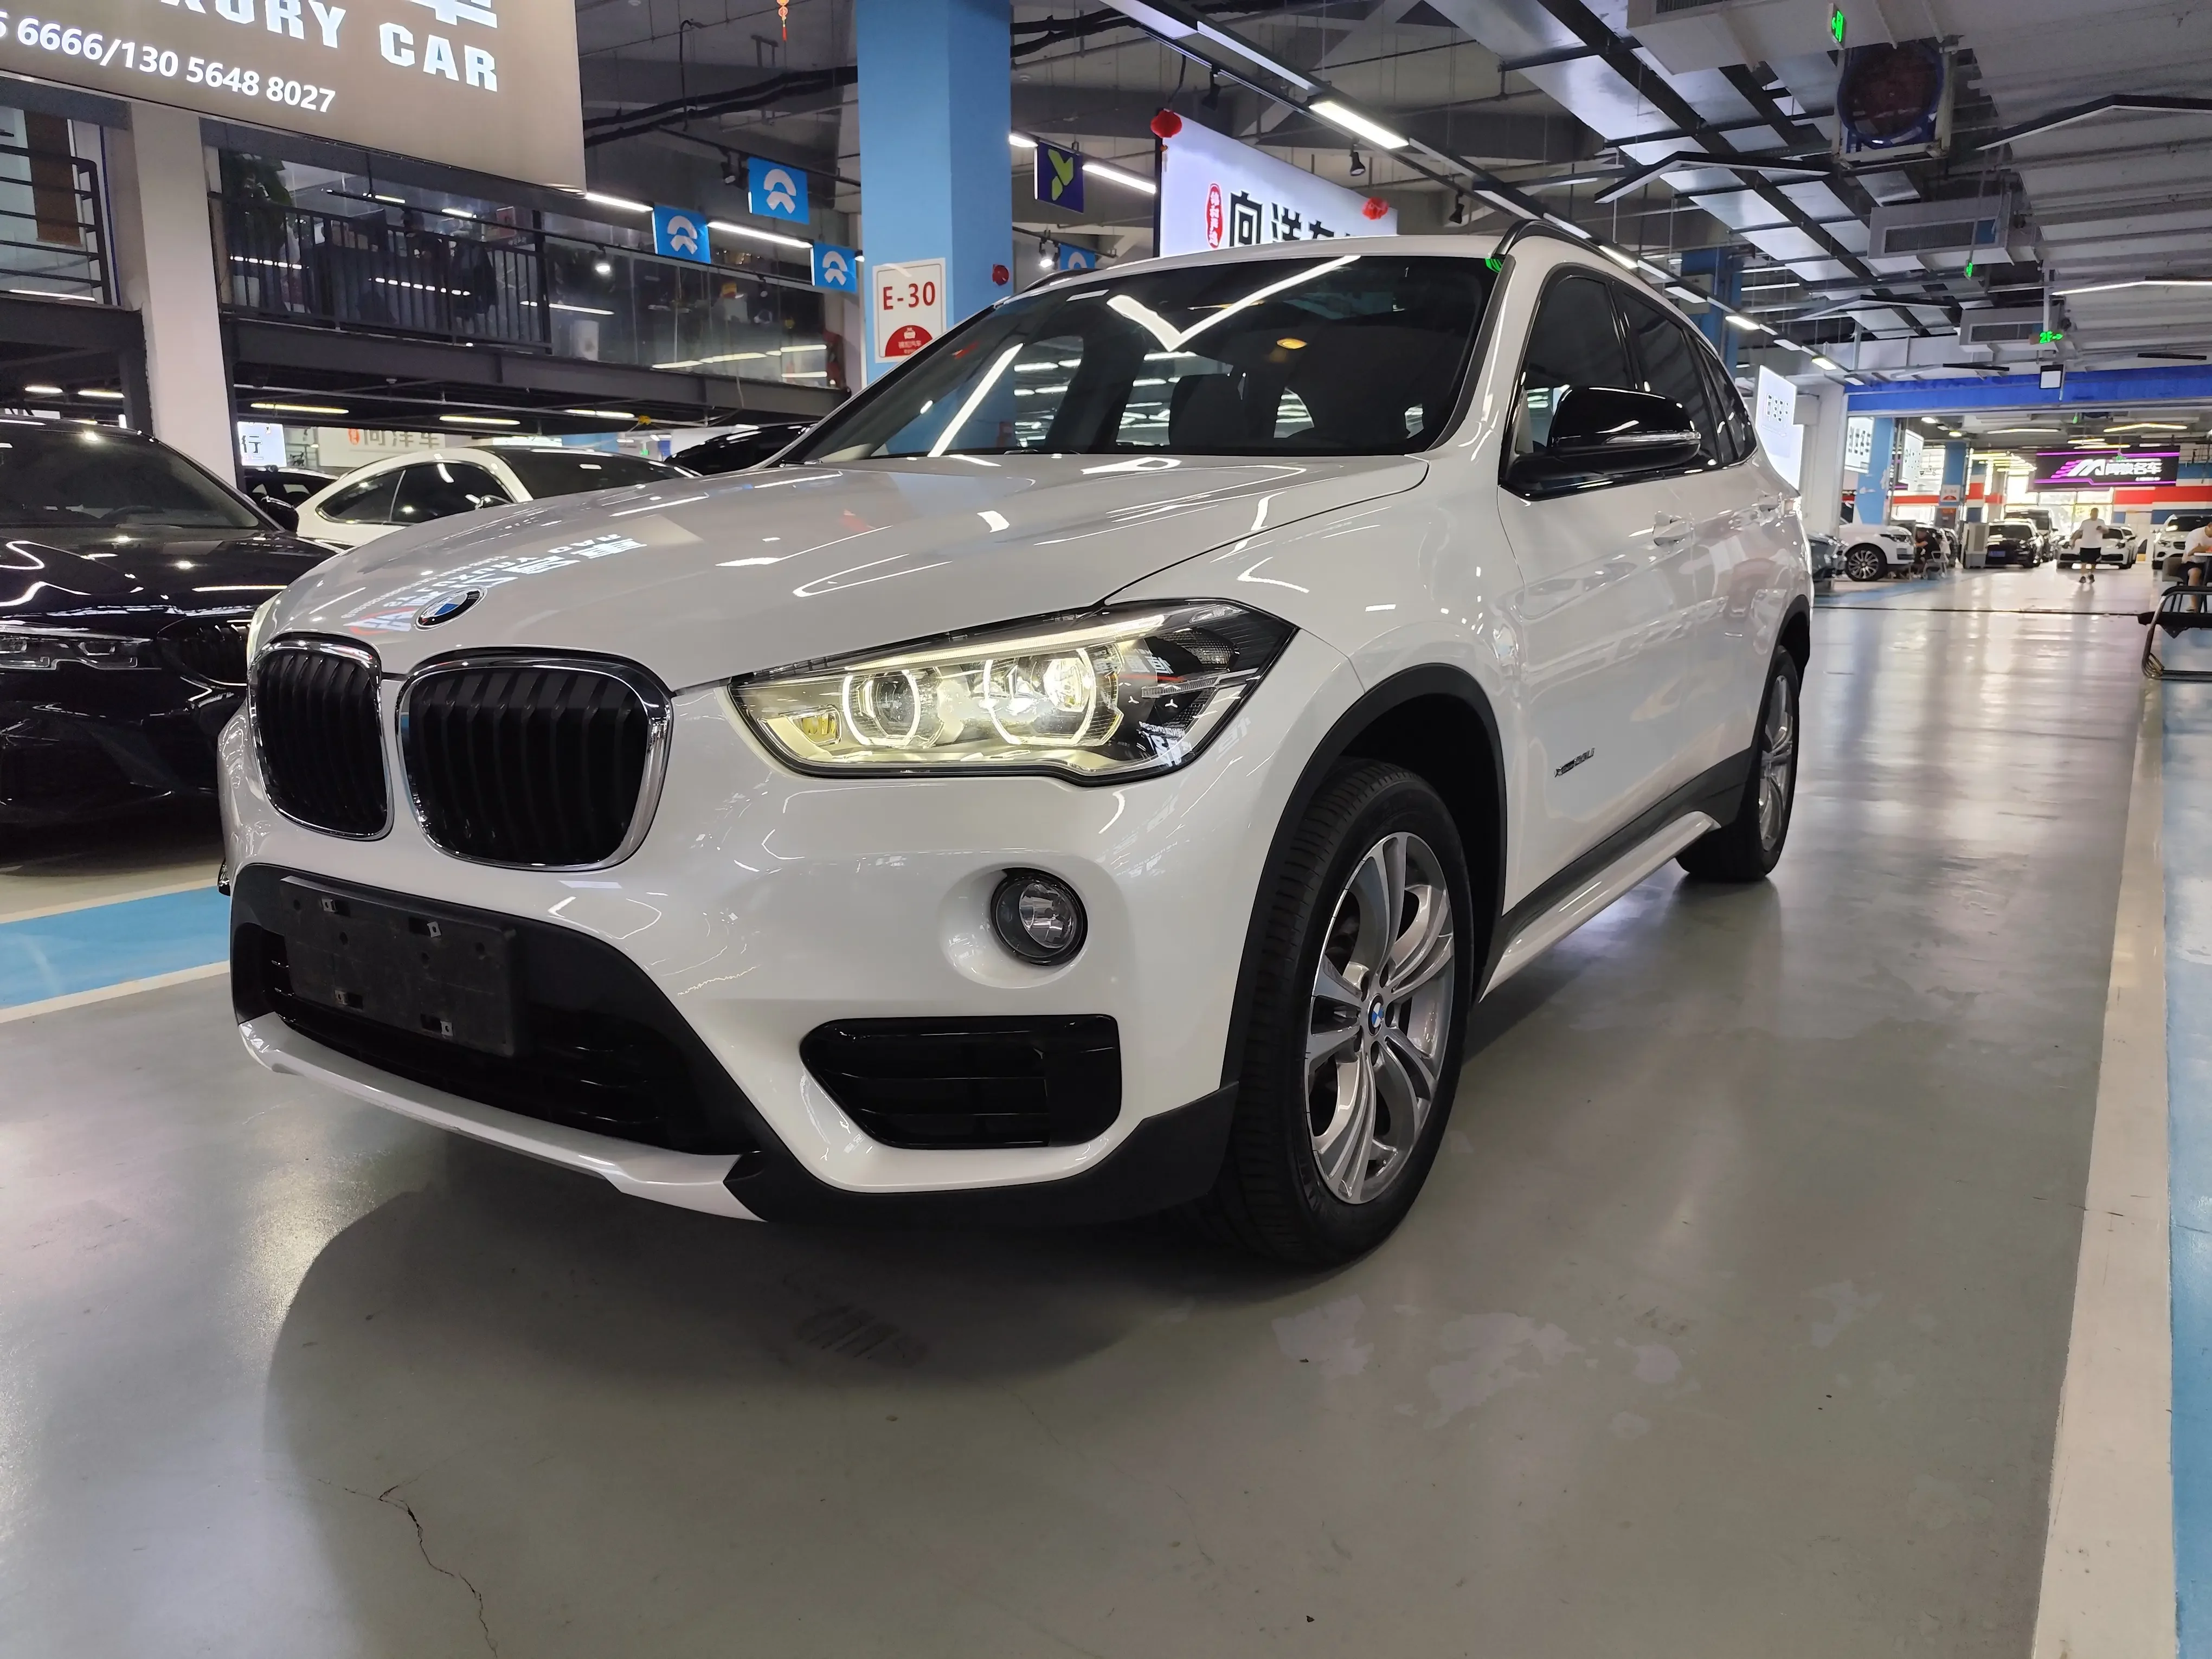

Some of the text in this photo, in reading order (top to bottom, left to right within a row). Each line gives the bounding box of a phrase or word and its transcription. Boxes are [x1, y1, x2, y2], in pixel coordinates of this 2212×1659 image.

[17, 17, 179, 77] 6666/130
[186, 56, 259, 97] 5648
[266, 76, 336, 113] 8027
[380, 22, 498, 92] CAR
[883, 281, 936, 311] E-30
